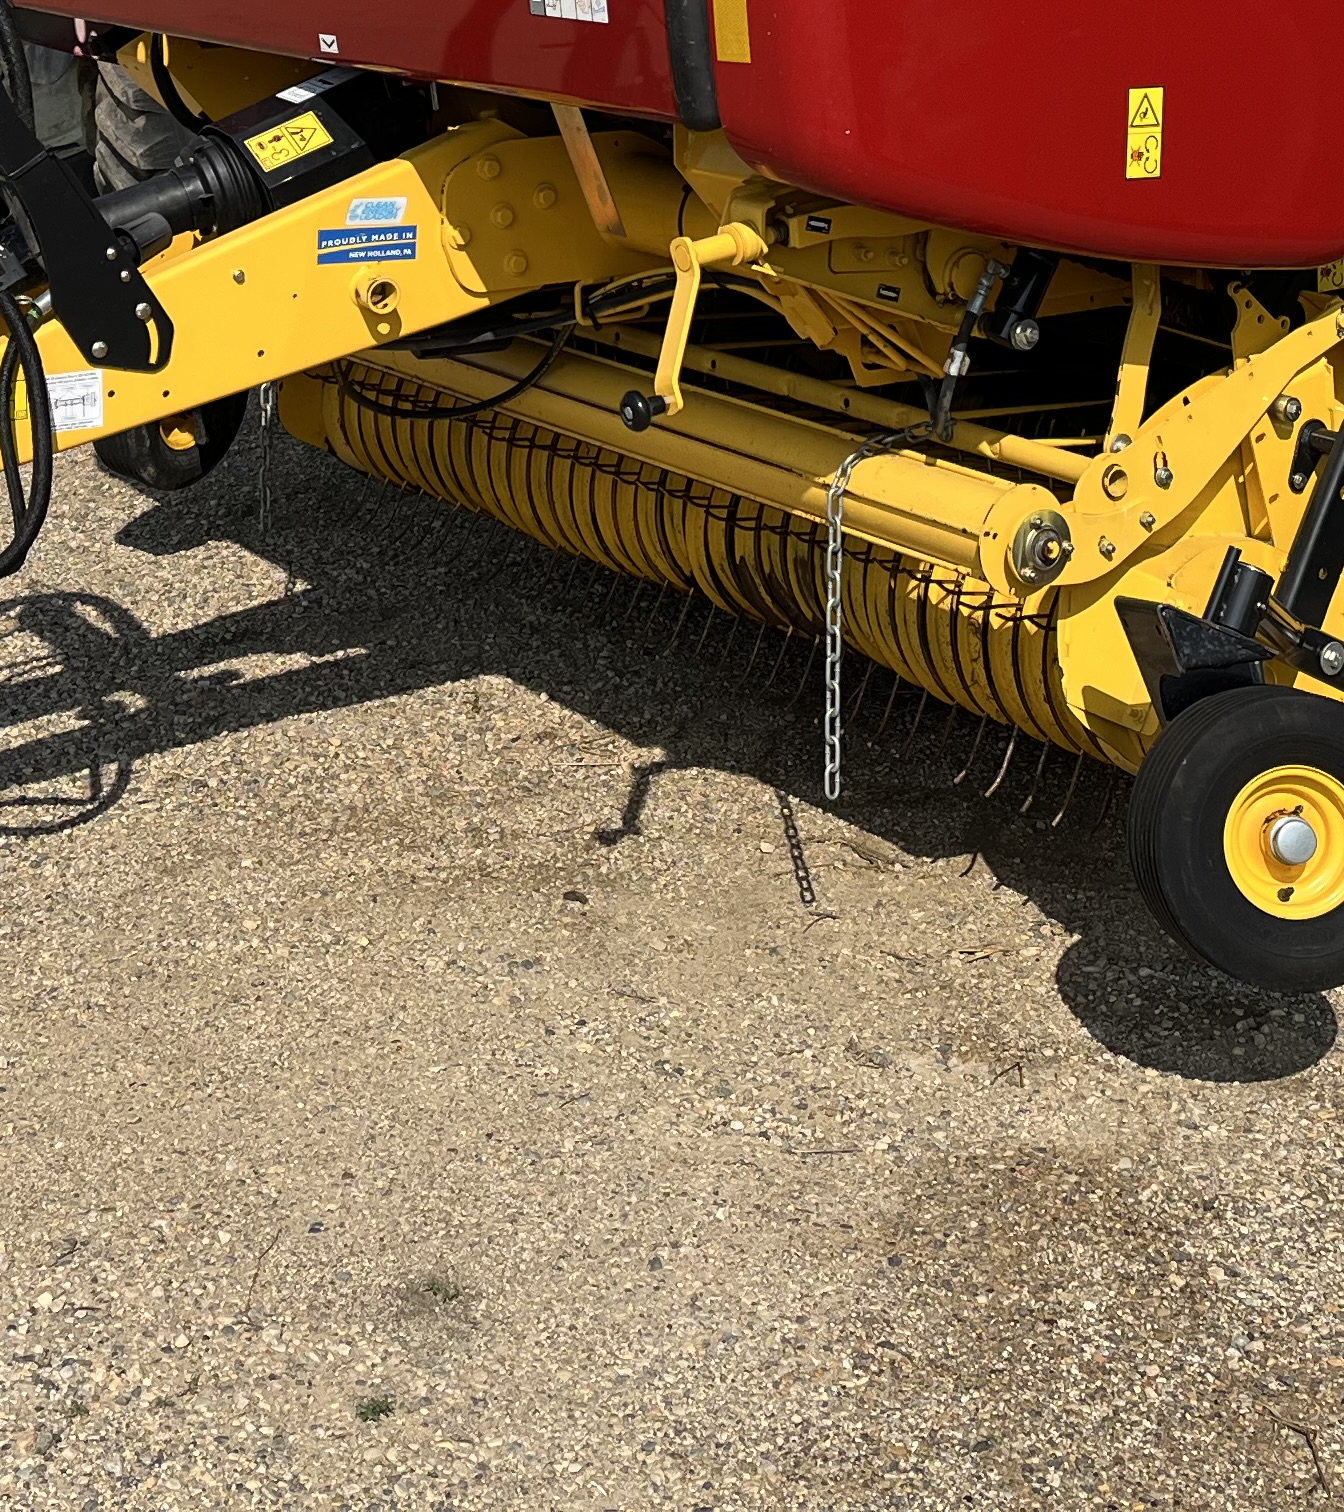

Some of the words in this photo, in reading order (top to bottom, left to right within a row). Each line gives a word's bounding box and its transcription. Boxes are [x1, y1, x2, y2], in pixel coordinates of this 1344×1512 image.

[321, 235, 368, 248] PROUDLY
[371, 232, 399, 242] MADE
[402, 231, 413, 240] IN
[349, 251, 366, 259] NEW
